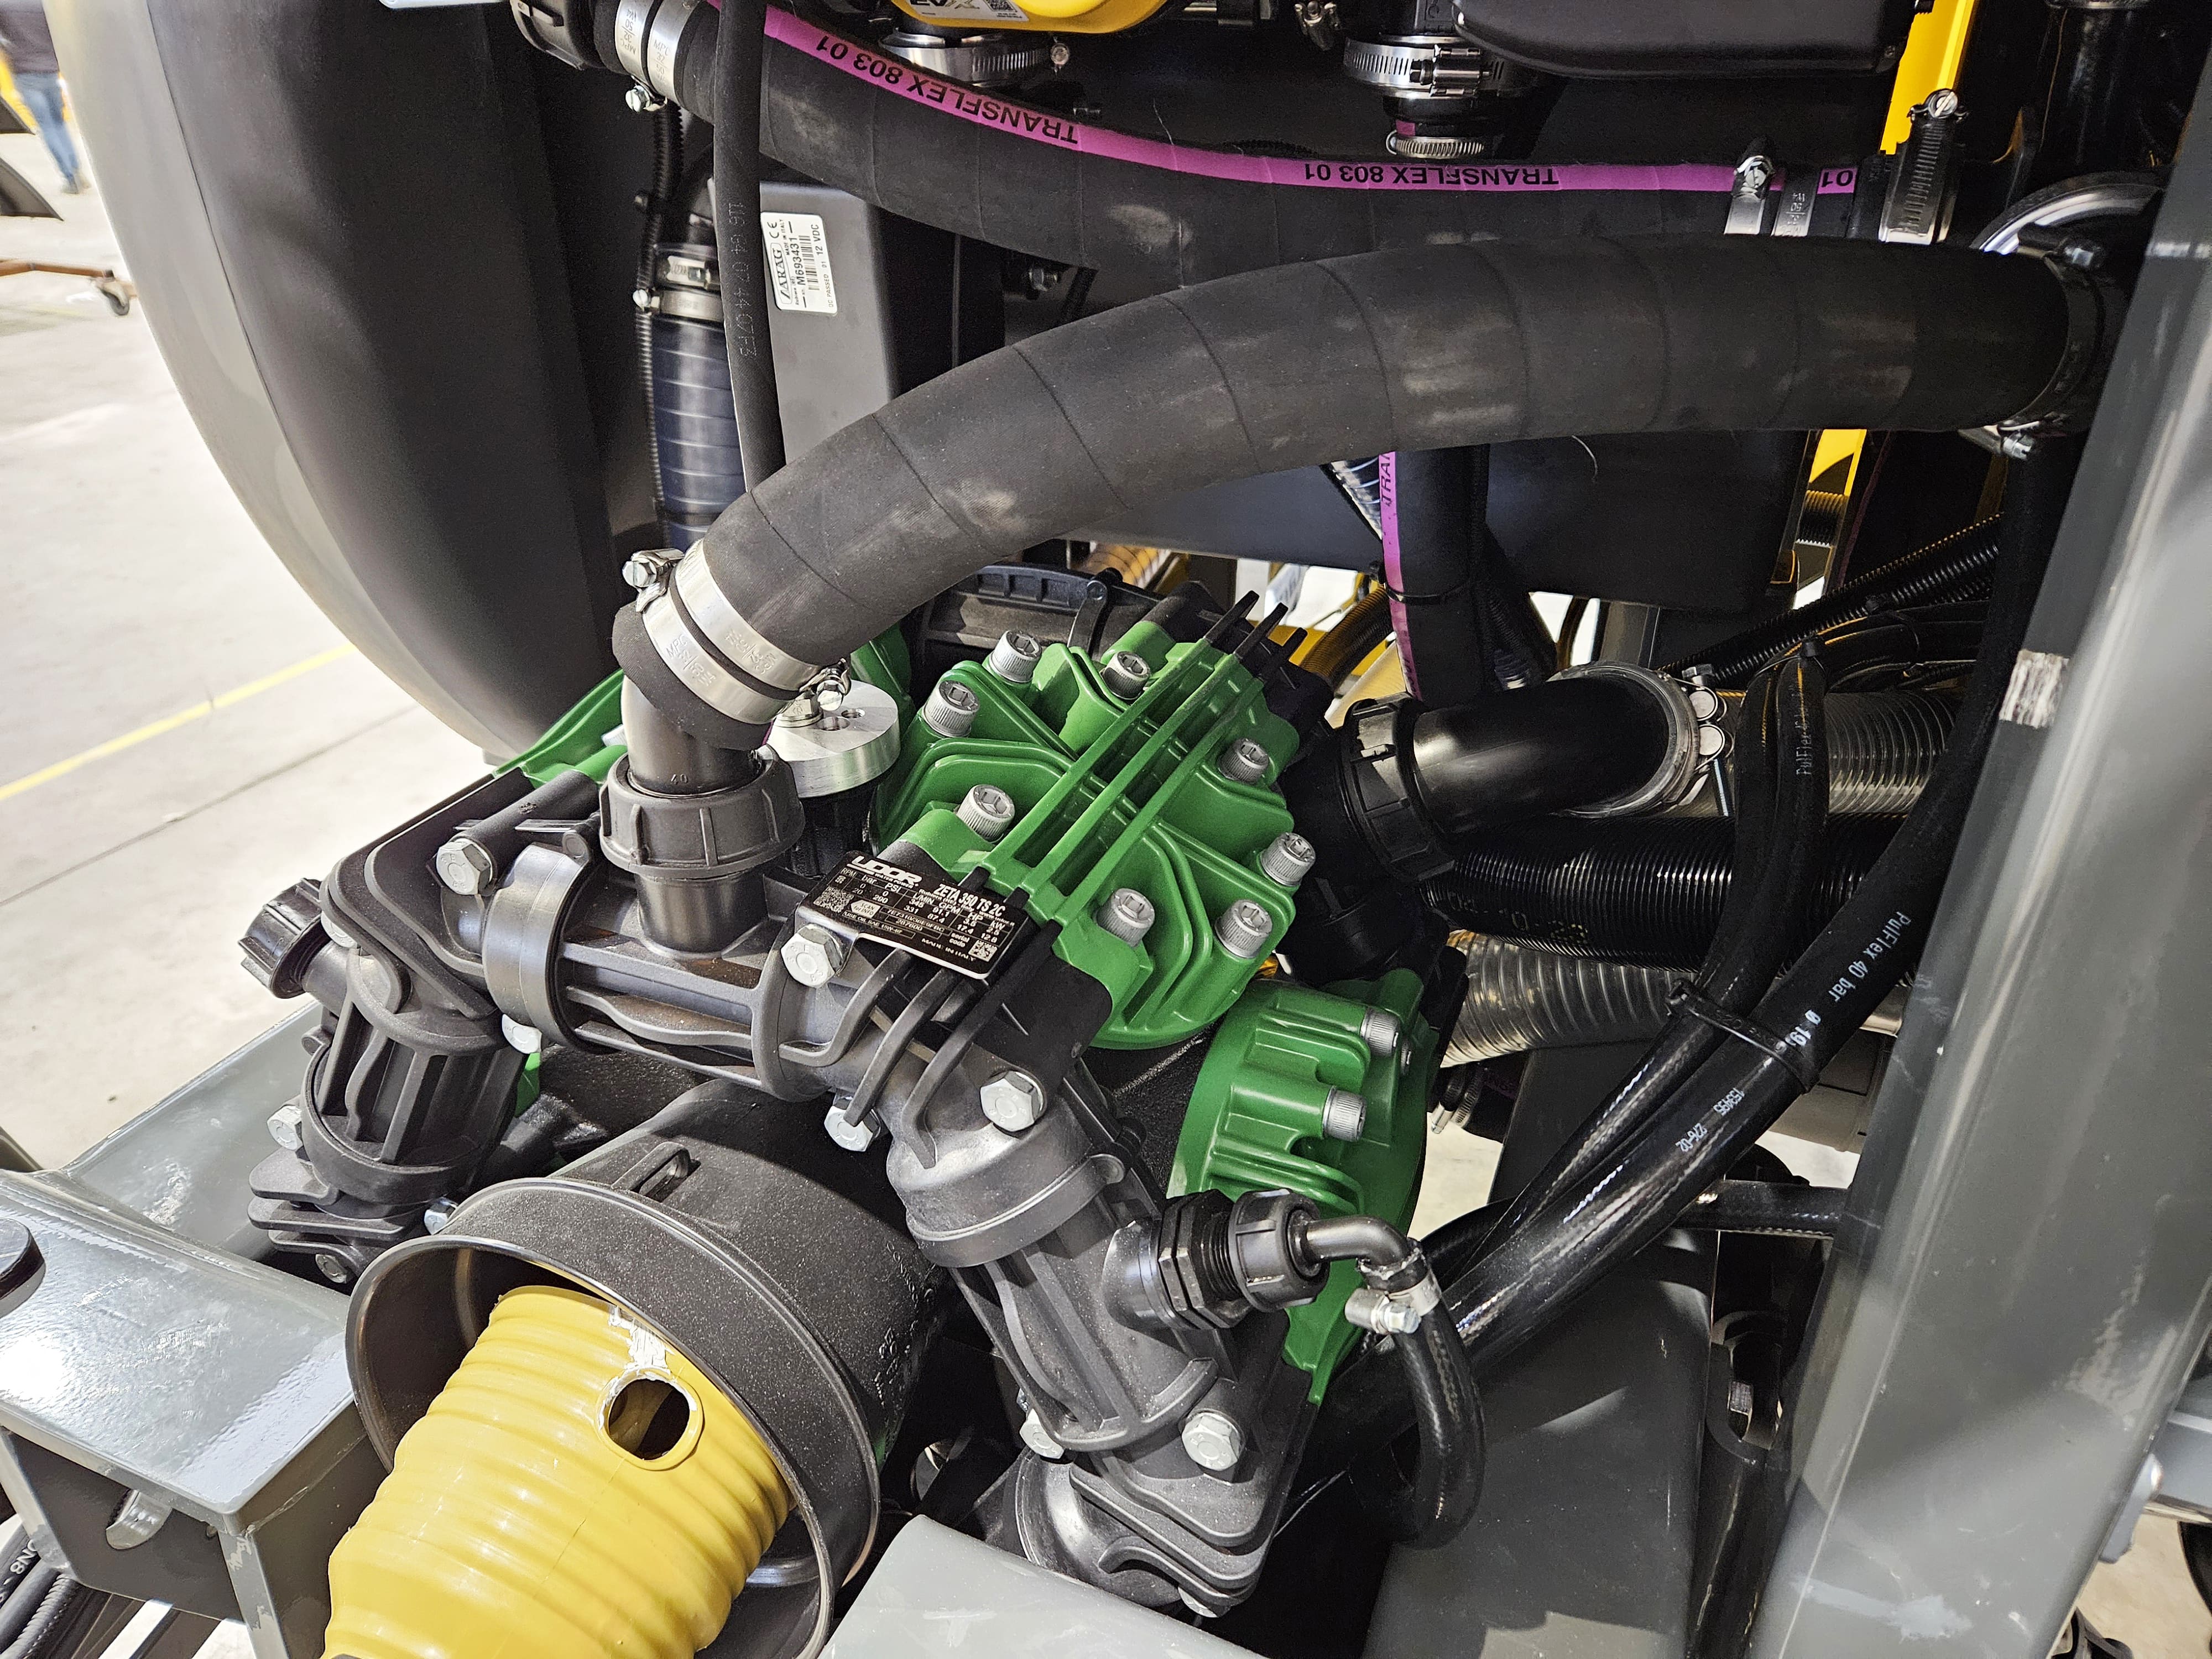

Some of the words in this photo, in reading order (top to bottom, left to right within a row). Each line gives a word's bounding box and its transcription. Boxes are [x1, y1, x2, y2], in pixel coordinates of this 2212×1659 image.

[816, 35, 849, 60] 01
[853, 52, 903, 85] 803
[906, 75, 1078, 144] TRANSFLEX
[1305, 164, 1331, 180] 01
[1340, 166, 1383, 183] 803
[1392, 166, 1559, 185] TRANSFLEX
[1822, 170, 1853, 187] 01
[811, 225, 821, 242] VDC
[789, 237, 806, 285] M693431
[816, 246, 823, 255] 12
[773, 248, 790, 299] ARAG
[823, 274, 832, 297] PASSED
[666, 634, 687, 660] MPC
[852, 855, 922, 885] UDOR
[841, 868, 857, 877] RPM
[861, 874, 877, 884] bar
[885, 883, 902, 893] PSI
[913, 893, 935, 905] L/MIN
[938, 902, 961, 915] GPM
[968, 912, 983, 921] HP
[990, 920, 1005, 930] kW
[860, 902, 875, 910] SCAN
[932, 906, 950, 917] 91.1
[933, 883, 961, 903] ZETA
[958, 893, 978, 907] 350
[976, 898, 992, 912] TS
[989, 904, 1005, 917] 2C
[873, 894, 888, 903] 290
[904, 905, 919, 914] 331
[927, 913, 945, 924] 87.4
[957, 924, 974, 934] 17.4
[949, 938, 966, 948] code
[951, 933, 970, 943] serial
[1863, 912, 1911, 960] PulFlex
[1848, 961, 1869, 979] 40
[1828, 977, 1856, 1002] bar
[1713, 1088, 1745, 1117] 153495
[1675, 1123, 1708, 1152] 276-02
